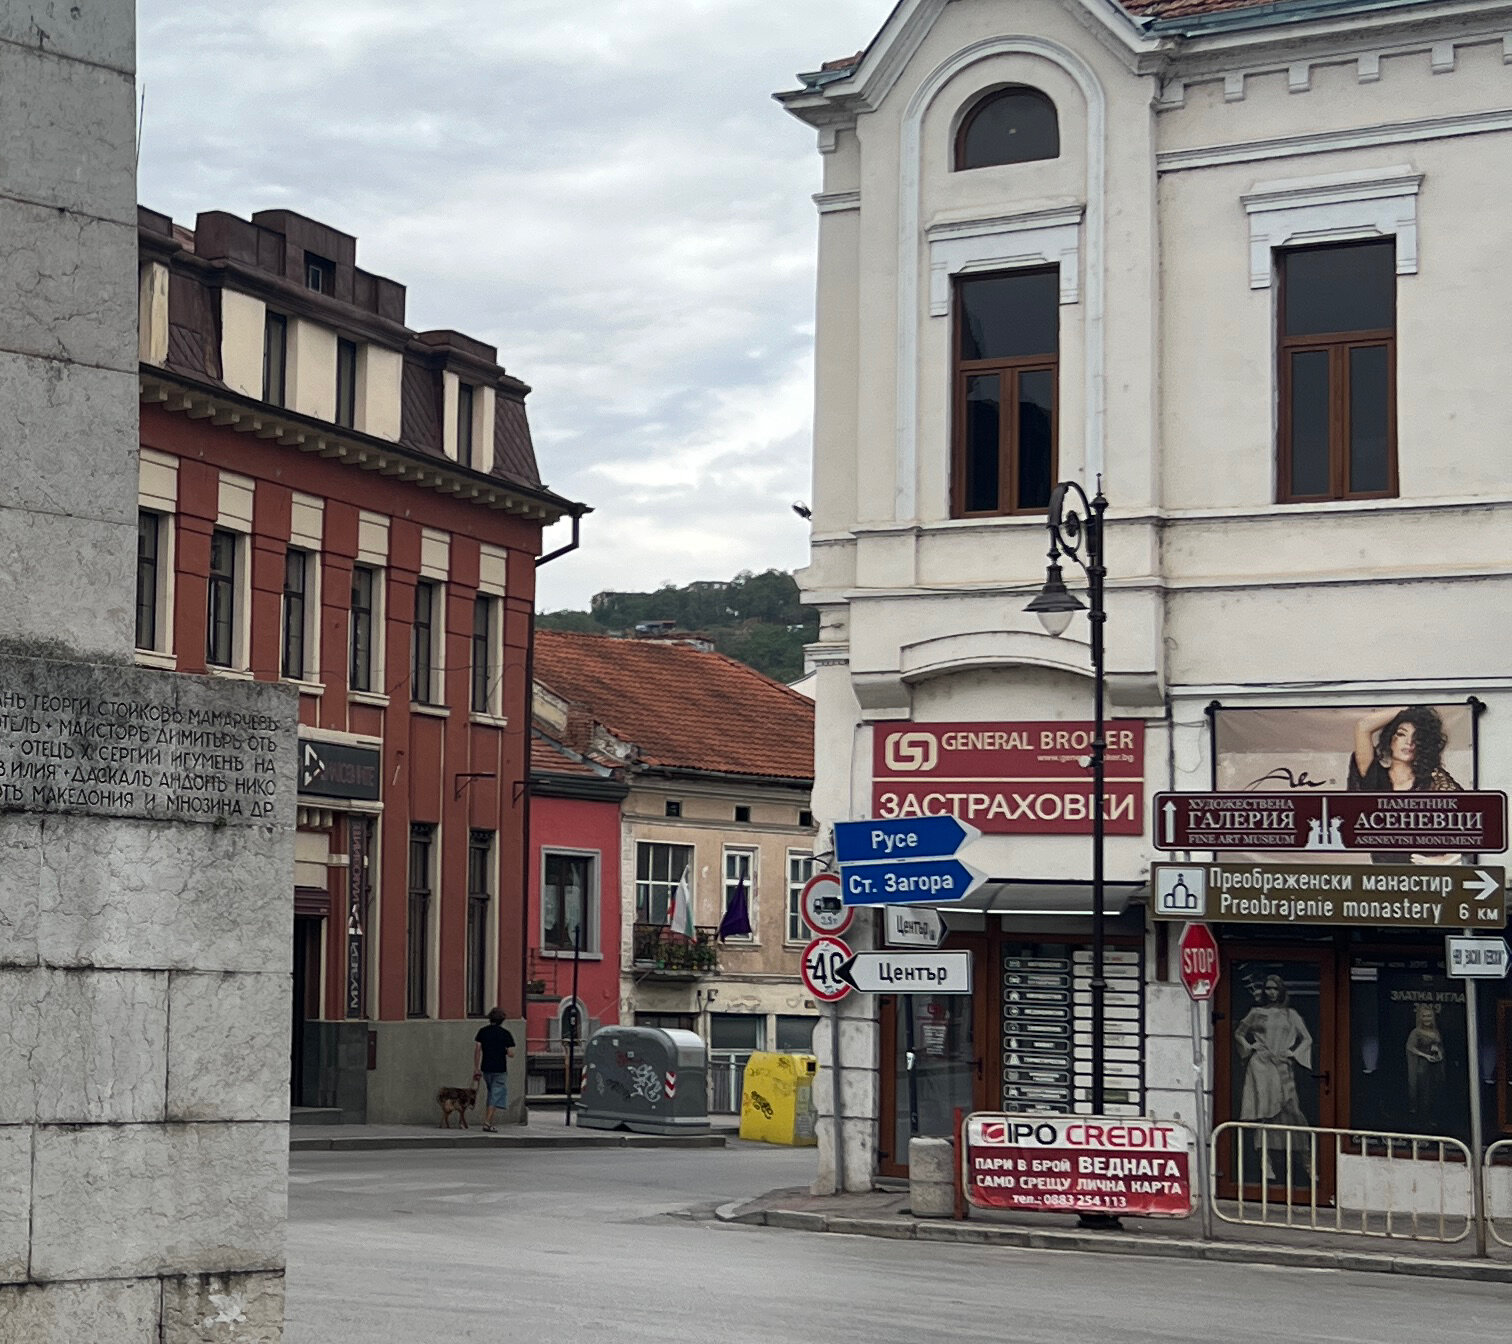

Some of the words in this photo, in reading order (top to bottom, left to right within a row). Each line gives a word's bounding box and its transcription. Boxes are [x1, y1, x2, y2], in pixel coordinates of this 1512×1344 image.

[34, 694, 90, 714] ГЕОРГИ
[247, 735, 278, 753] ОТЪ
[941, 732, 1034, 750] GENERAL
[21, 740, 74, 760] ОТЕЦЪ
[170, 750, 245, 772] ИГУМЕНЪ
[254, 757, 276, 774] НА
[71, 765, 153, 788] ДАСКАЛЪ
[235, 777, 277, 797] НИКО
[32, 786, 134, 808] МАКЕДОНИЯ
[144, 793, 156, 810] И
[166, 794, 243, 816] МНОЗИНА
[1188, 799, 1295, 810] ХУДОЖЕСТВЕНА
[1377, 798, 1458, 810] ПАМЕТНИК
[1187, 811, 1296, 829] ГАЛЕРИЯ
[1354, 811, 1483, 832] АСЕНЕВЦИ
[871, 830, 919, 853] Русе
[1188, 834, 1216, 844] FINE
[1219, 834, 1240, 844] ART
[1243, 834, 1296, 845] MUSEUM
[1354, 835, 1414, 846] ASENEVTSI
[1416, 835, 1484, 846] MONUMENT
[849, 875, 878, 894] Ст.
[884, 873, 955, 895] Загора
[1209, 866, 1353, 894] Преображенски
[1362, 875, 1453, 897] манастир
[1221, 894, 1334, 920] Preobrajenie
[1343, 898, 1442, 924] monastery
[1459, 903, 1470, 921] 6
[896, 914, 929, 940] Център
[812, 951, 845, 985] 40
[1183, 947, 1215, 974] STOP
[879, 962, 948, 986] Център
[1007, 1122, 1058, 1146] IPO
[1065, 1124, 1175, 1149] CREDIT
[975, 1158, 1013, 1172] ПАРИ
[1017, 1160, 1028, 1171] В
[1031, 1159, 1071, 1173] БРОЙ
[1078, 1156, 1181, 1178] ВЕДНАГА
[975, 1174, 1016, 1189] САМО
[1019, 1177, 1072, 1192] СРЕЩУ
[1076, 1179, 1127, 1193] ЛИЧНА
[1131, 1181, 1182, 1195] КАРТА
[1044, 1194, 1074, 1206] 0883
[1077, 1195, 1101, 1206] 254
[1103, 1196, 1127, 1208] 113
